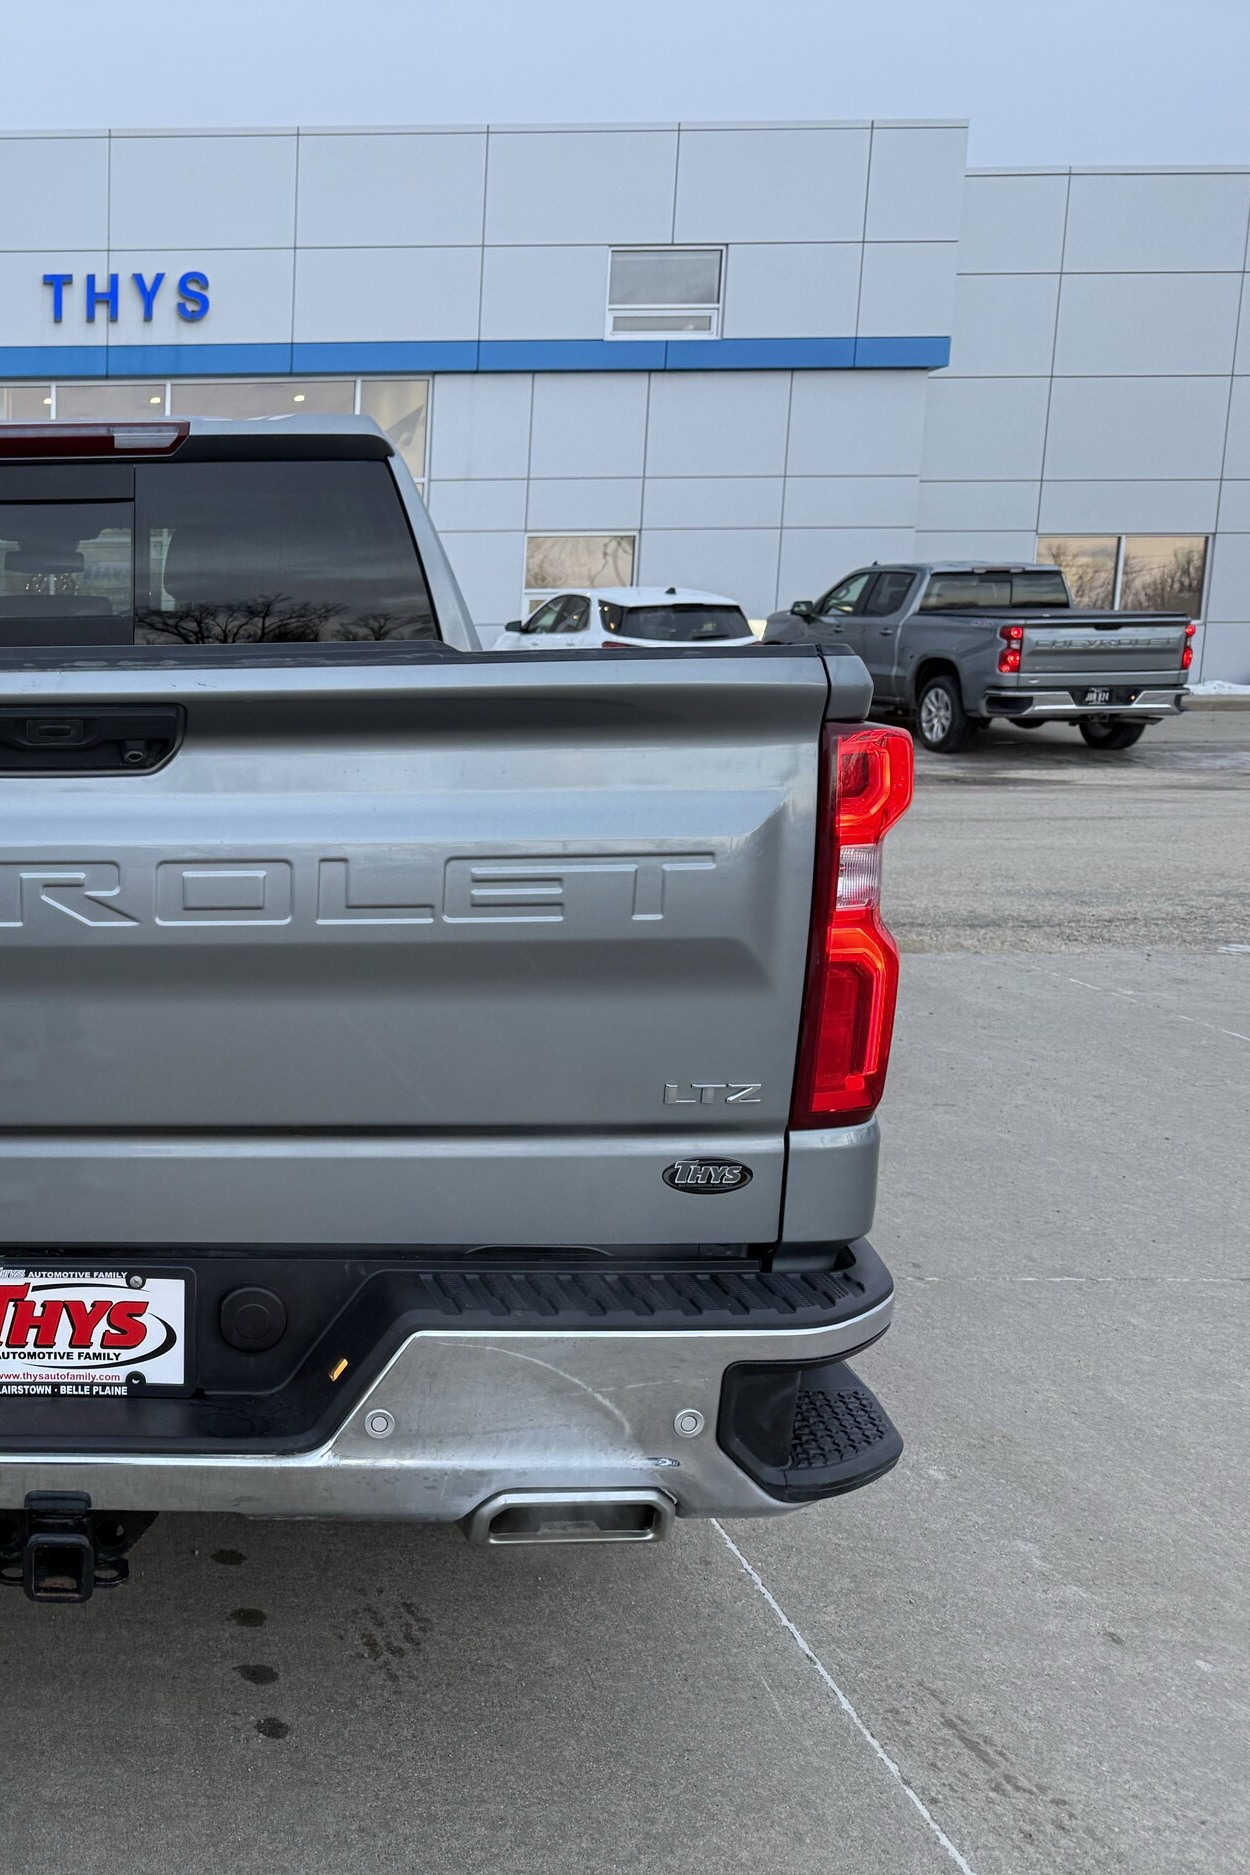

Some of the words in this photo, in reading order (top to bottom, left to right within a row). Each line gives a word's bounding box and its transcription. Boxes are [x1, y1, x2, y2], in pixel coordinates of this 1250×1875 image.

[42, 271, 210, 323] THYS
[663, 1083, 762, 1104] LTZ
[674, 1160, 742, 1184] THYS
[28, 1271, 91, 1279] AUTOMOTIVE
[93, 1271, 128, 1279] FAMILY
[77, 1351, 122, 1361] FAMILY
[59, 1386, 91, 1395] BELLE
[92, 1386, 128, 1396] PLAINE
